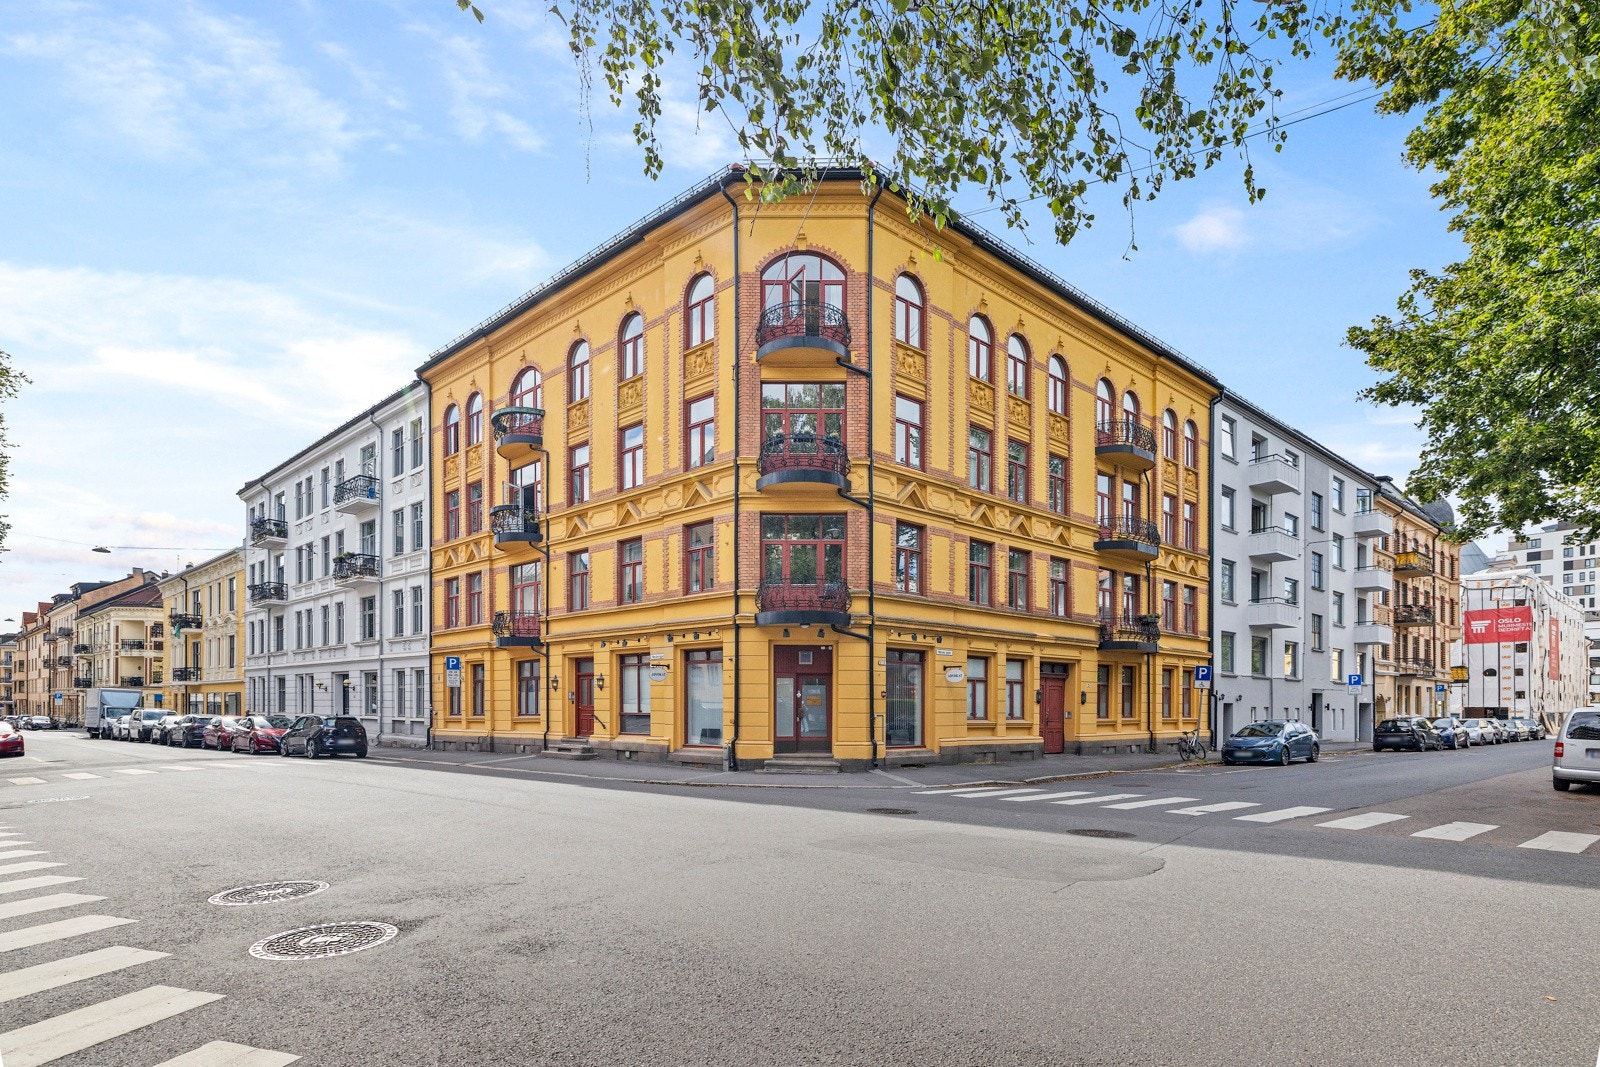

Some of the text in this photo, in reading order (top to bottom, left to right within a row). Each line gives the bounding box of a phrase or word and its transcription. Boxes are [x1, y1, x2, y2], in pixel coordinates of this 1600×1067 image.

[449, 658, 457, 669] P
[1198, 667, 1208, 679] P
[1351, 675, 1359, 685] P
